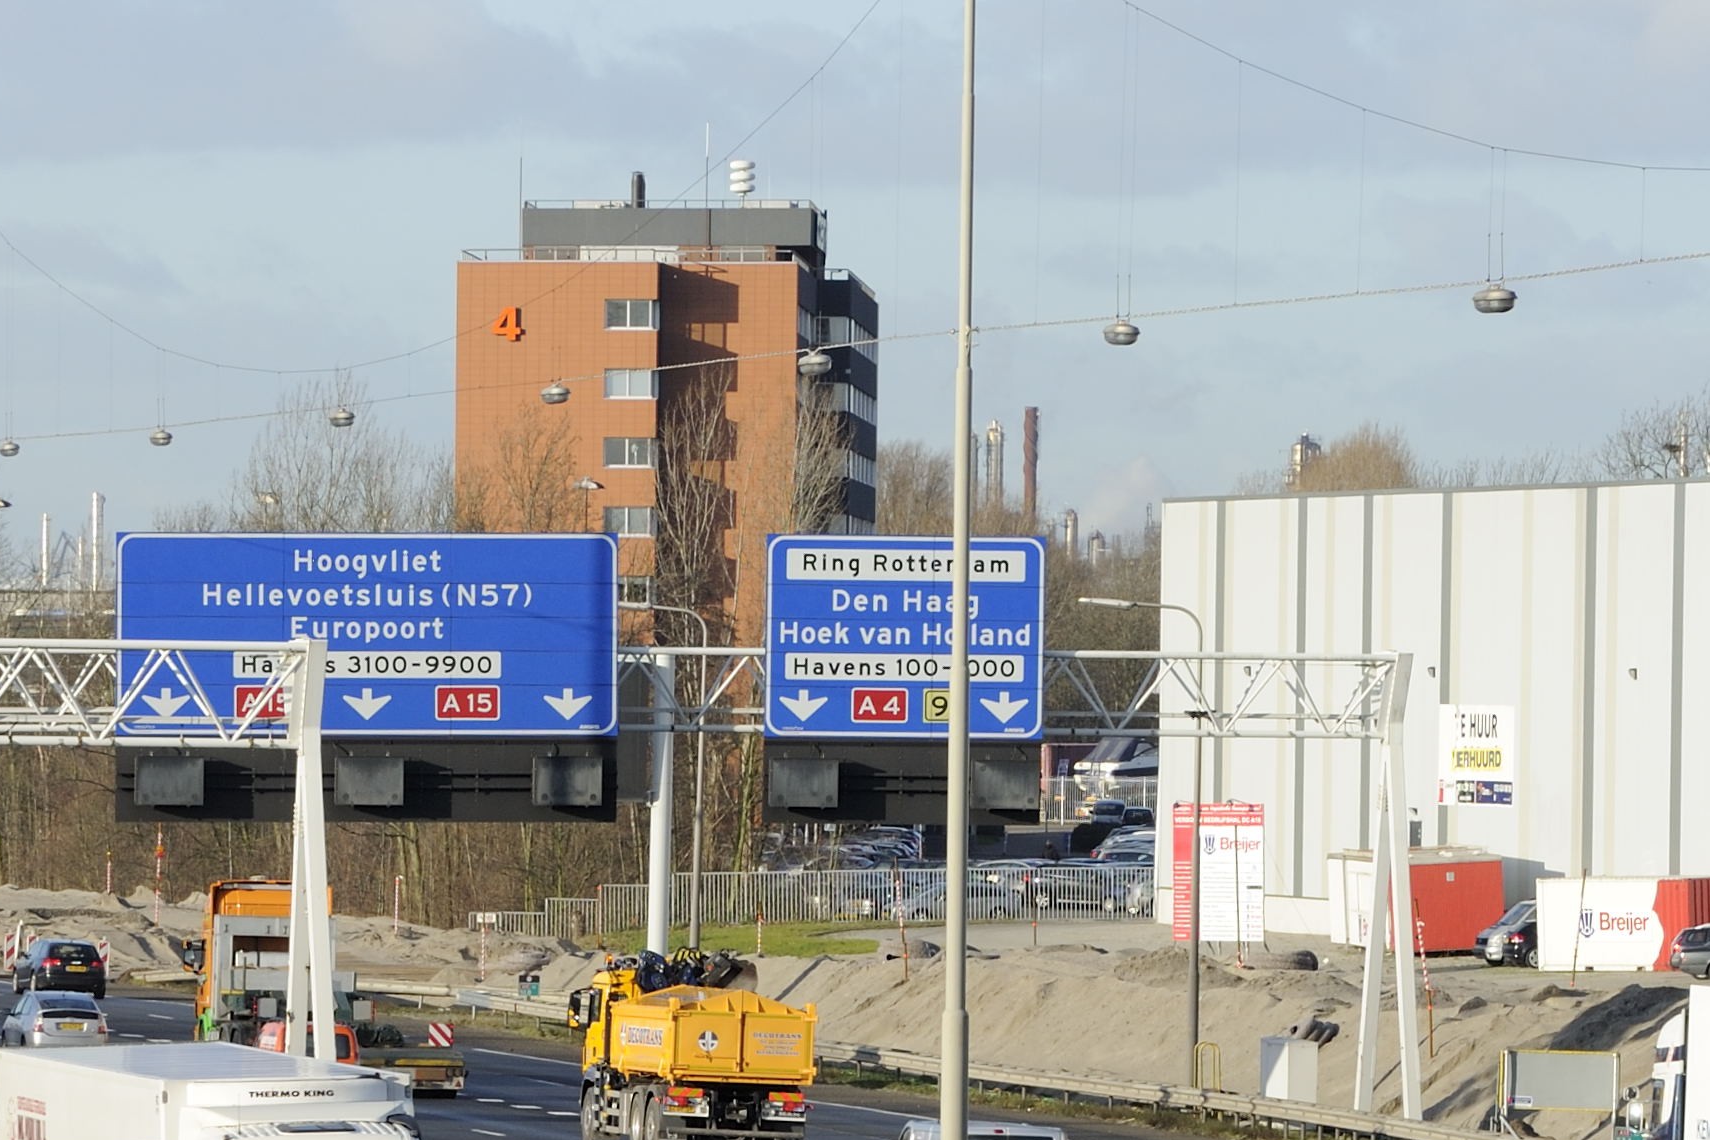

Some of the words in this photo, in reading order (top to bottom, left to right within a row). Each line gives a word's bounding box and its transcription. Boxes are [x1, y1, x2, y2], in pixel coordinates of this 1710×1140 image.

[492, 307, 524, 341] 4
[293, 550, 442, 579] Hoogvliet
[803, 554, 860, 576] Ring
[874, 555, 1009, 573] Rotteram
[202, 583, 435, 608] Hellevoetsluis
[440, 583, 533, 609] (N57)
[831, 589, 888, 613] Den
[291, 616, 444, 644] Europoort
[779, 621, 850, 644] Hoek
[859, 626, 911, 645] van
[922, 623, 1031, 647] Holand
[241, 655, 336, 676] Has
[347, 655, 493, 676] 3100-9900
[793, 658, 886, 676] Havens
[896, 659, 1015, 677] 100-000
[1469, 713, 1498, 738] HUUR
[1219, 836, 1261, 854] Breijer
[1599, 911, 1650, 936] Breijer
[249, 1090, 300, 1098] THERMO
[303, 1089, 335, 1097] KING
